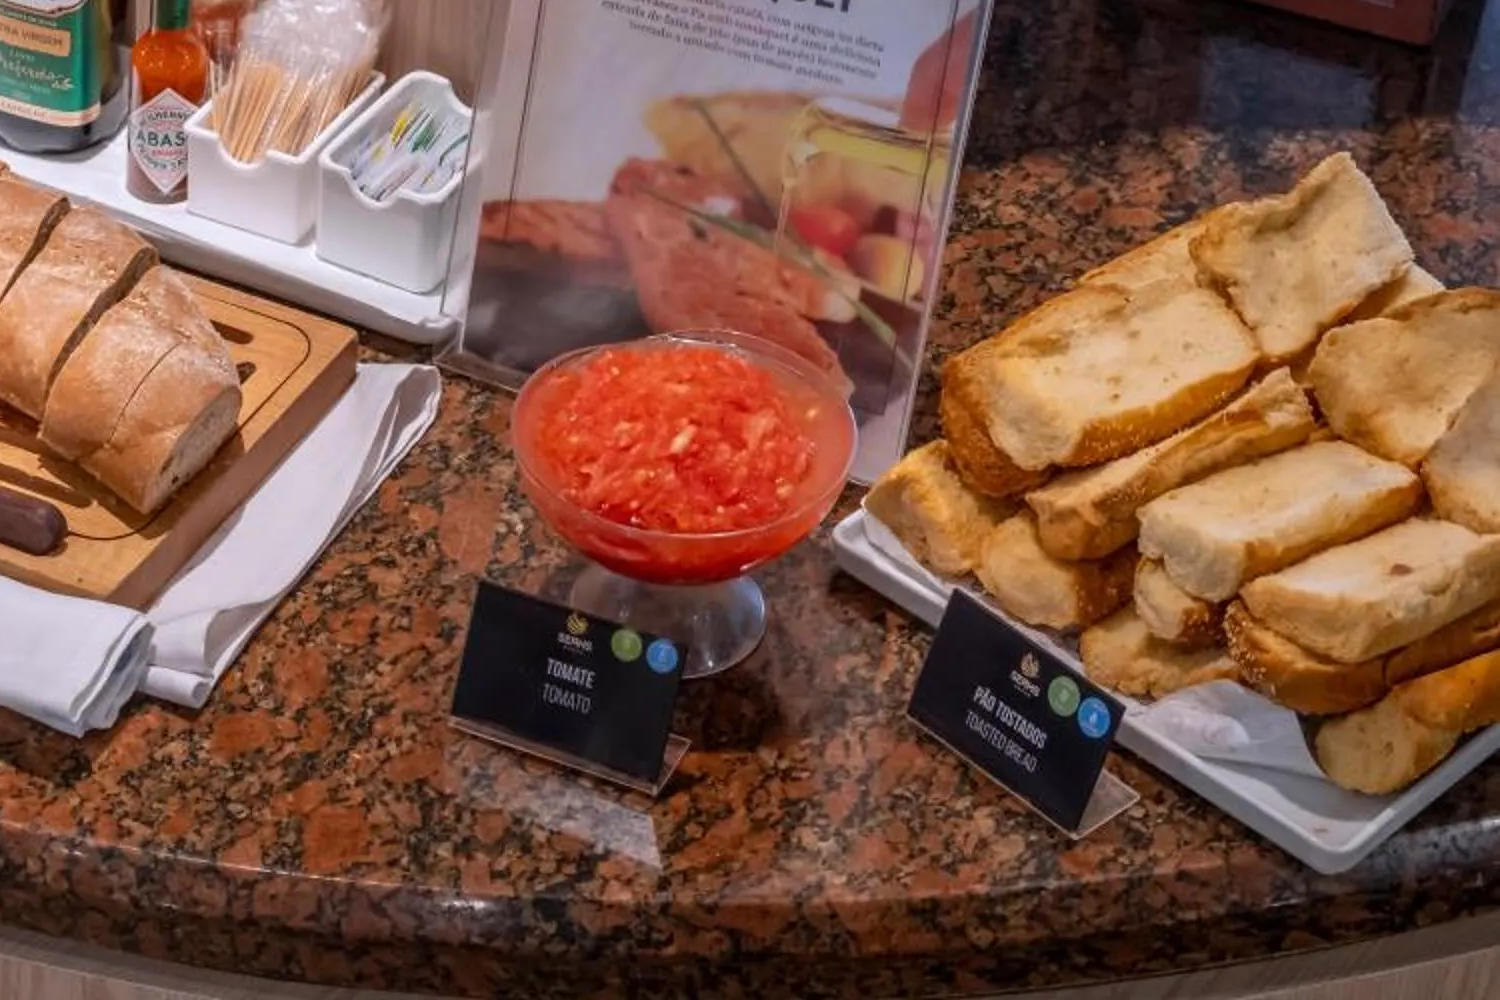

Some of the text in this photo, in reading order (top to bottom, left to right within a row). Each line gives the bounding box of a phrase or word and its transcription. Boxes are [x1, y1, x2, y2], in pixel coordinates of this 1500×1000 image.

[135, 129, 186, 147] ABAS
[547, 657, 596, 689] TOMATE
[543, 682, 591, 714] TOMATO
[996, 700, 1047, 749] TOSTADOS
[966, 709, 1038, 773] TOASTED BREAD
